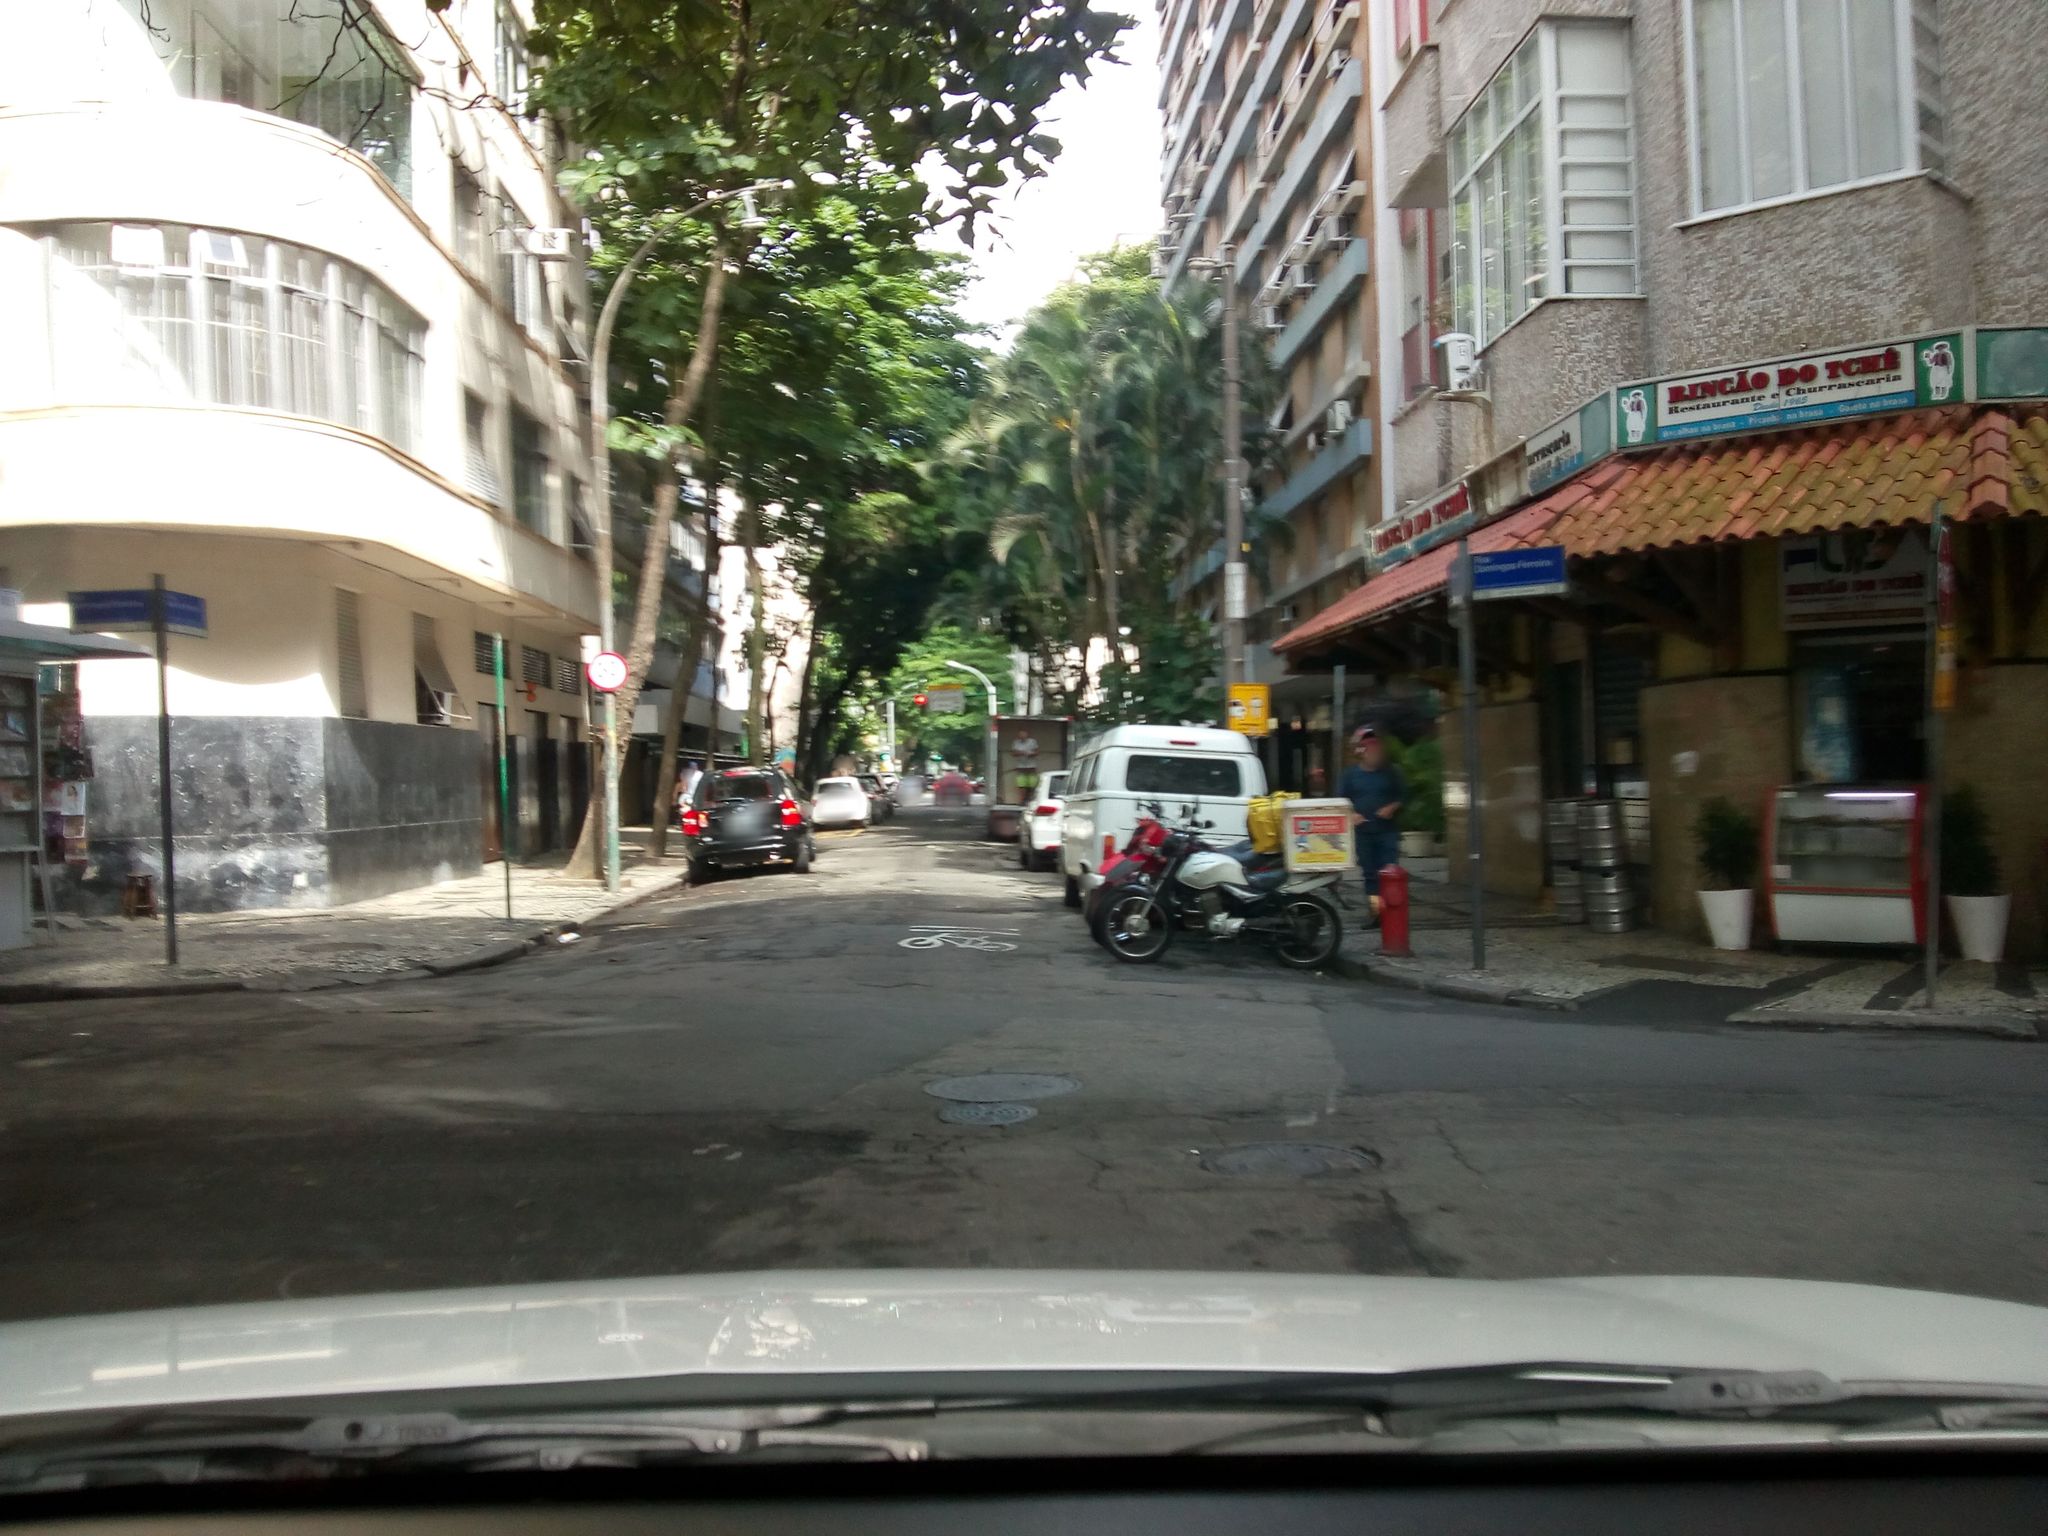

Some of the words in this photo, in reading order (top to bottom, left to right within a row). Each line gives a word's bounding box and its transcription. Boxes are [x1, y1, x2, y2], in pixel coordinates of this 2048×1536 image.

[1668, 369, 1770, 404] RINCÃO
[1777, 363, 1818, 387] DO
[1825, 346, 1899, 379] TCHÊ
[1668, 394, 1766, 415] Restaurante
[1785, 373, 1902, 397] Churrascaria
